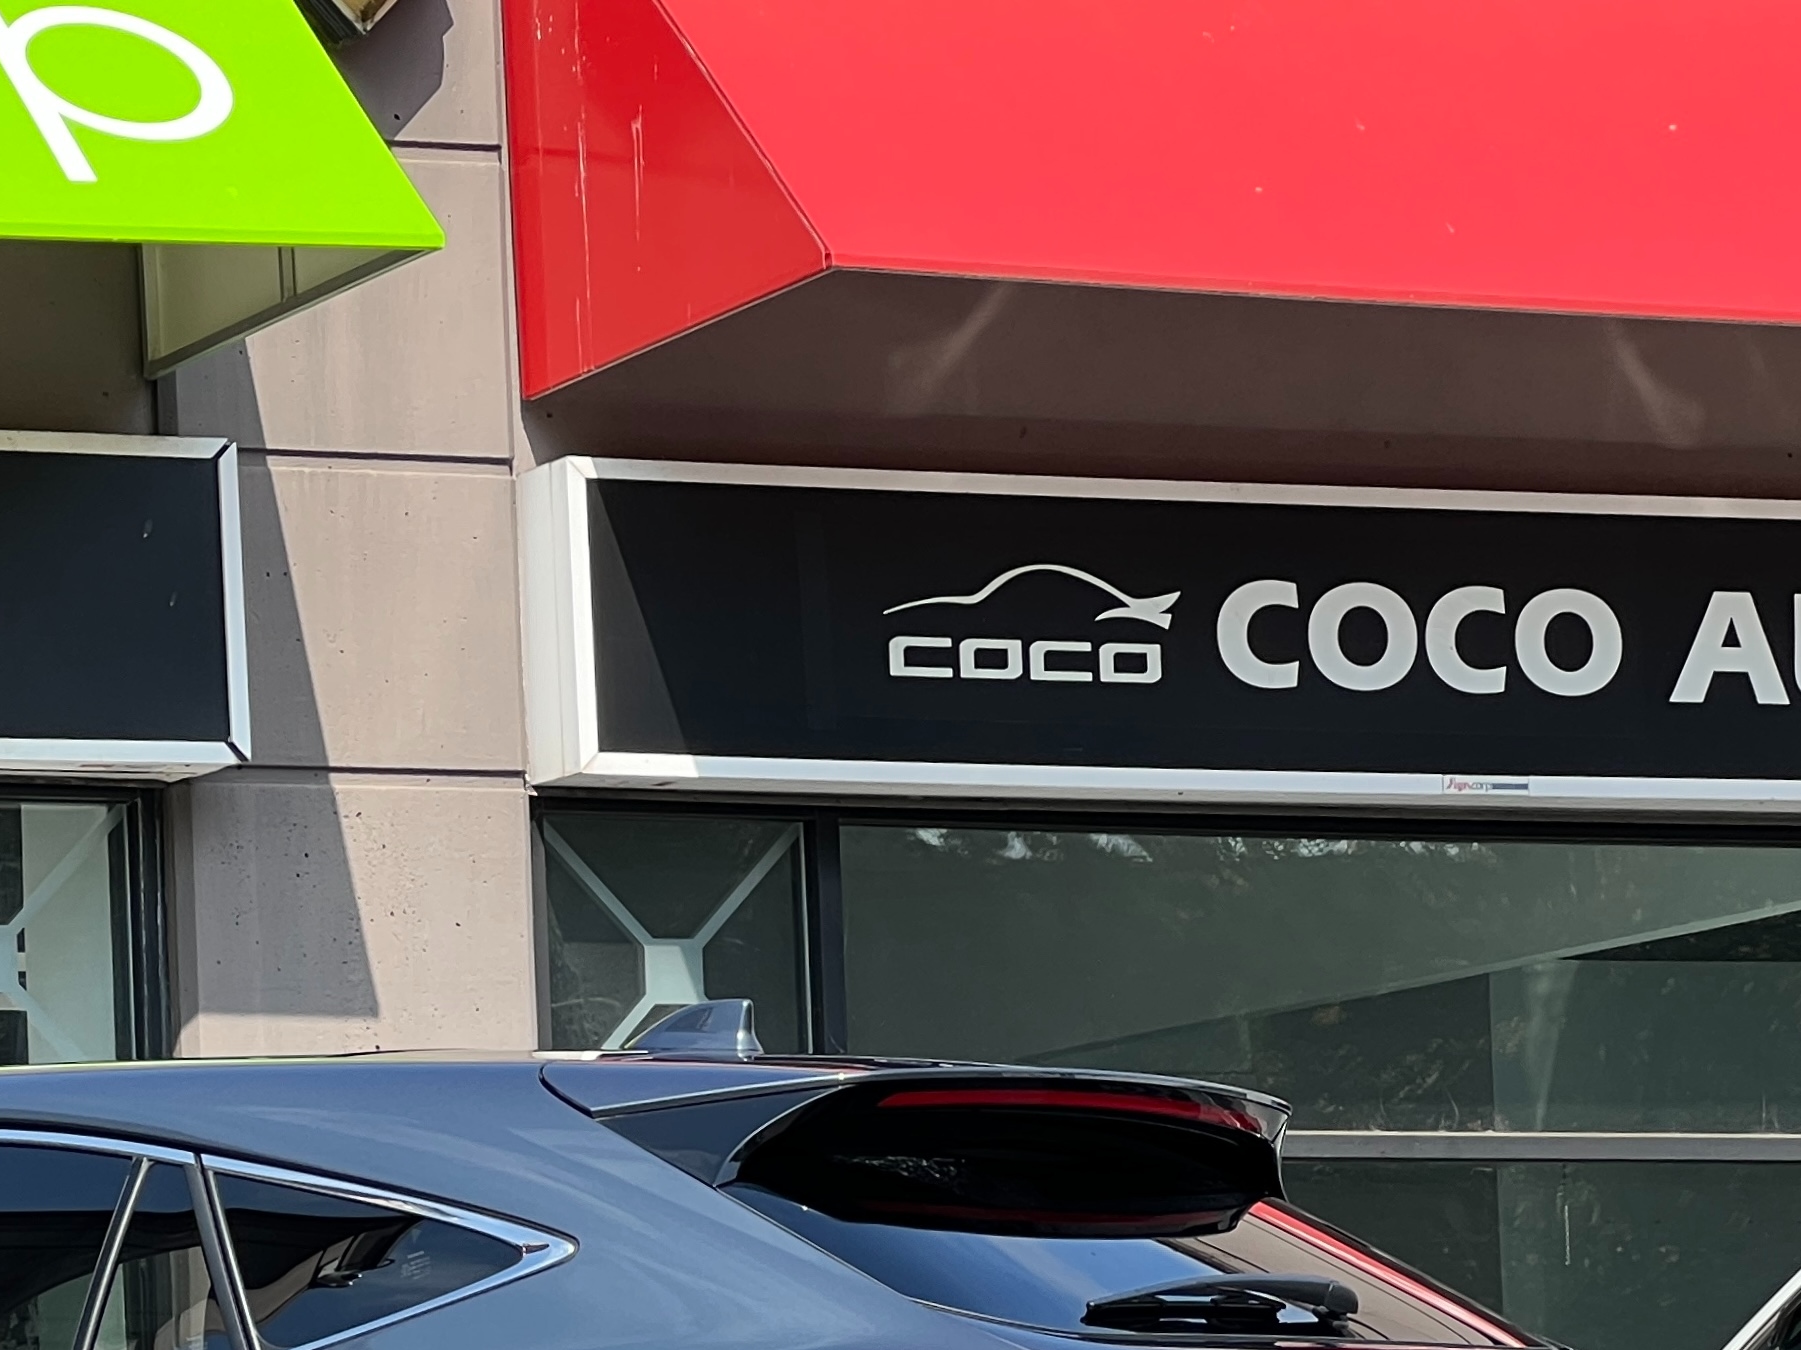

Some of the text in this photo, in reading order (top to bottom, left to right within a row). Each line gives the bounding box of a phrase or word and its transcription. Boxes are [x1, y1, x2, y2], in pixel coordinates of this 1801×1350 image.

[888, 636, 1162, 684] COCO
[1216, 579, 1801, 705] COCO A
